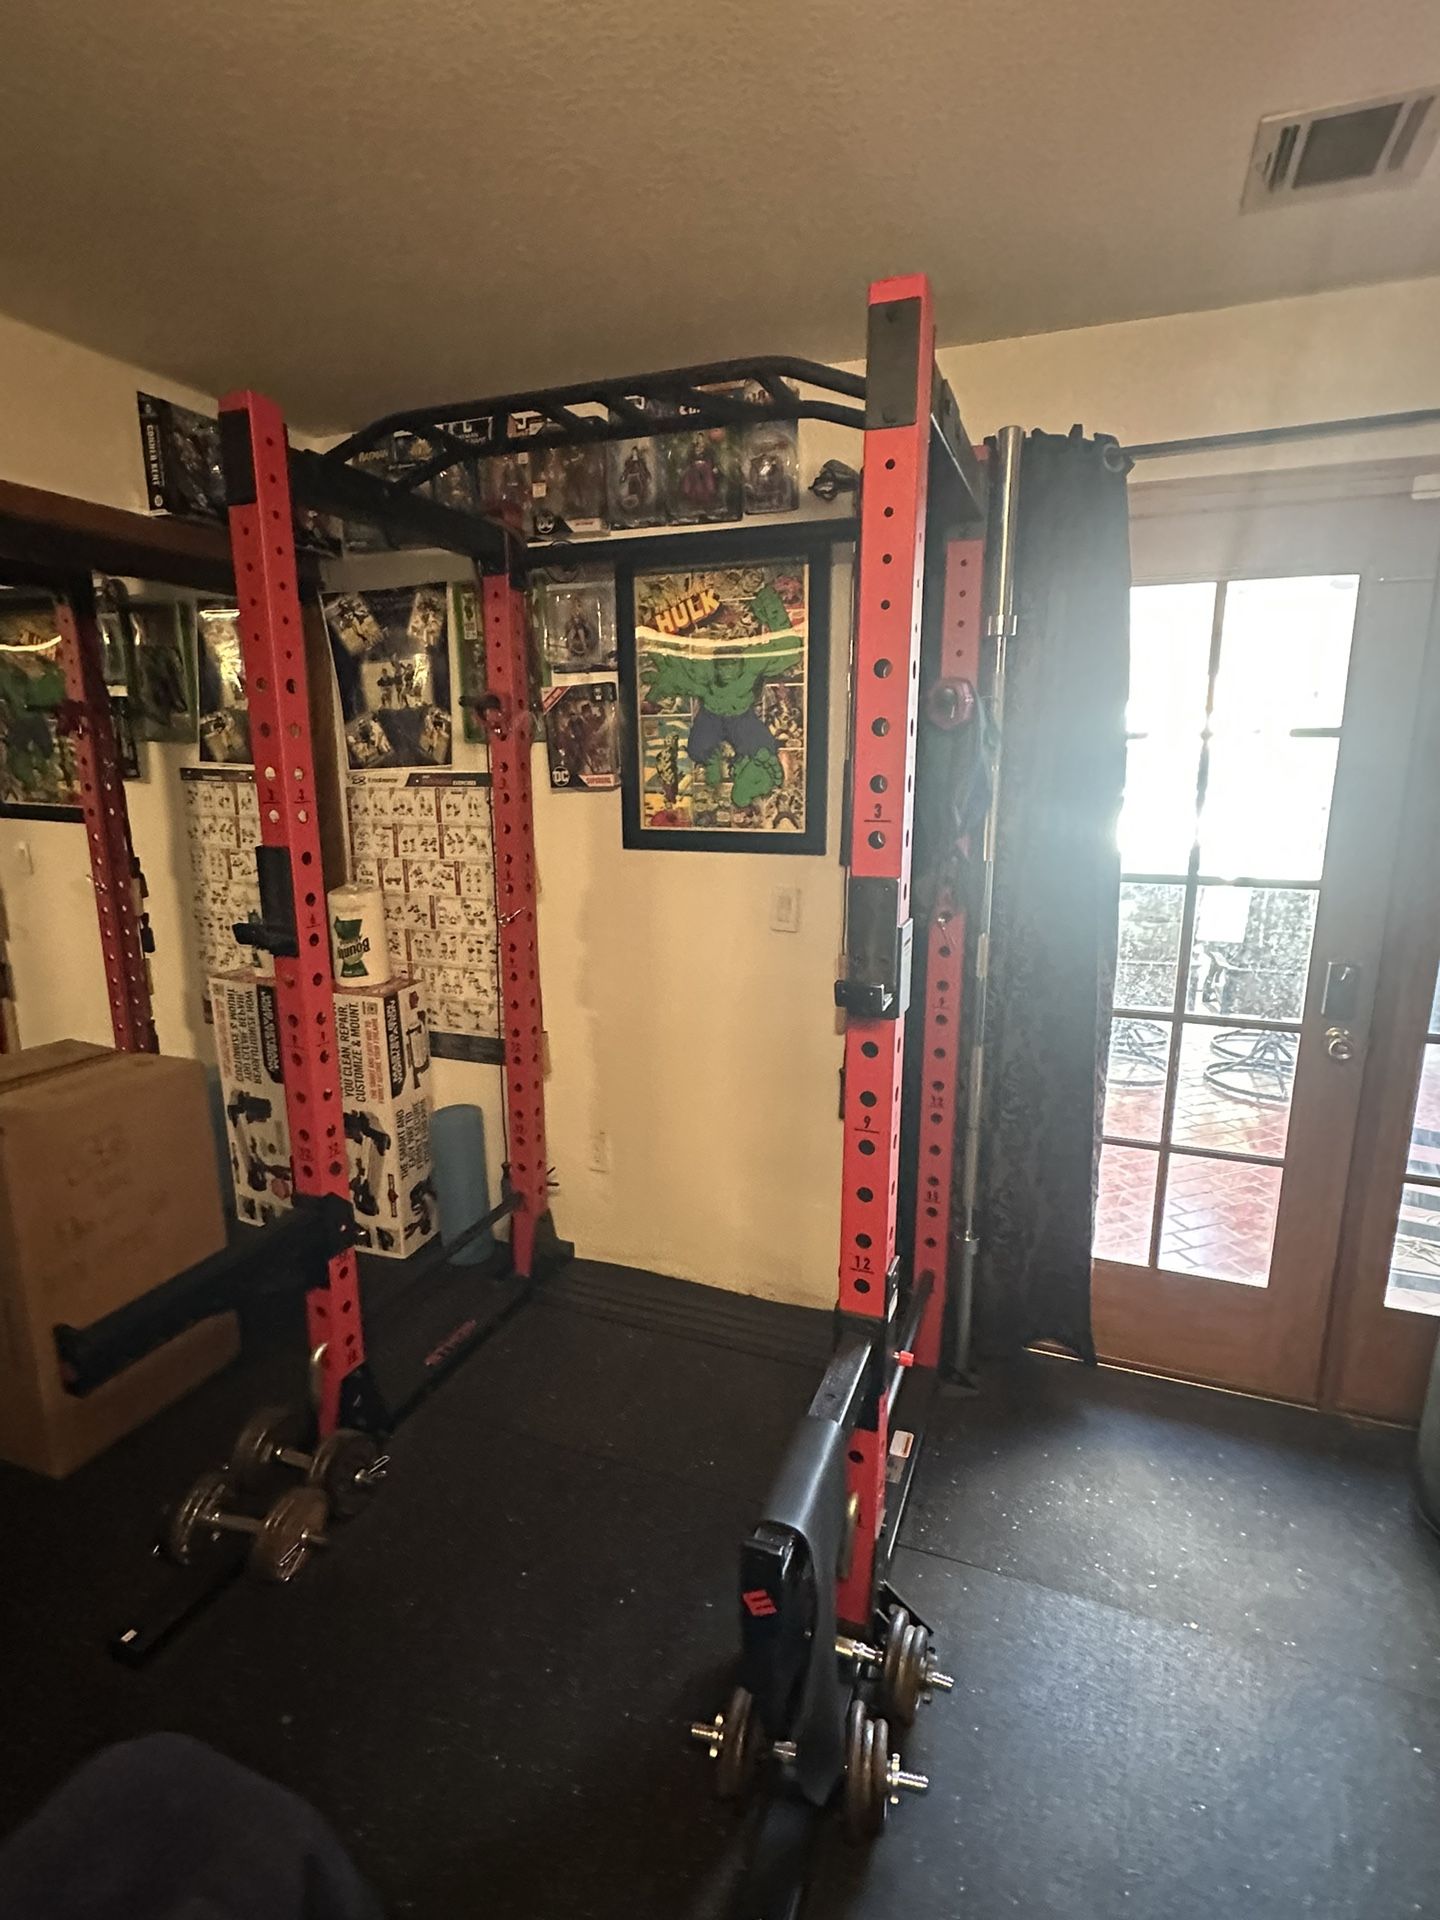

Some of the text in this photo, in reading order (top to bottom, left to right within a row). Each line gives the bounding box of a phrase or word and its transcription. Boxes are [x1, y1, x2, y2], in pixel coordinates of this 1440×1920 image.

[655, 588, 720, 633] HULK
[552, 768, 570, 784] DC
[874, 803, 882, 818] 3
[337, 937, 370, 960] Bounty
[353, 1039, 361, 1048] &
[353, 1049, 367, 1103] CUSTOMIZE
[343, 1078, 355, 1098] YOU
[864, 1115, 871, 1129] 9
[855, 1255, 870, 1272] 12
